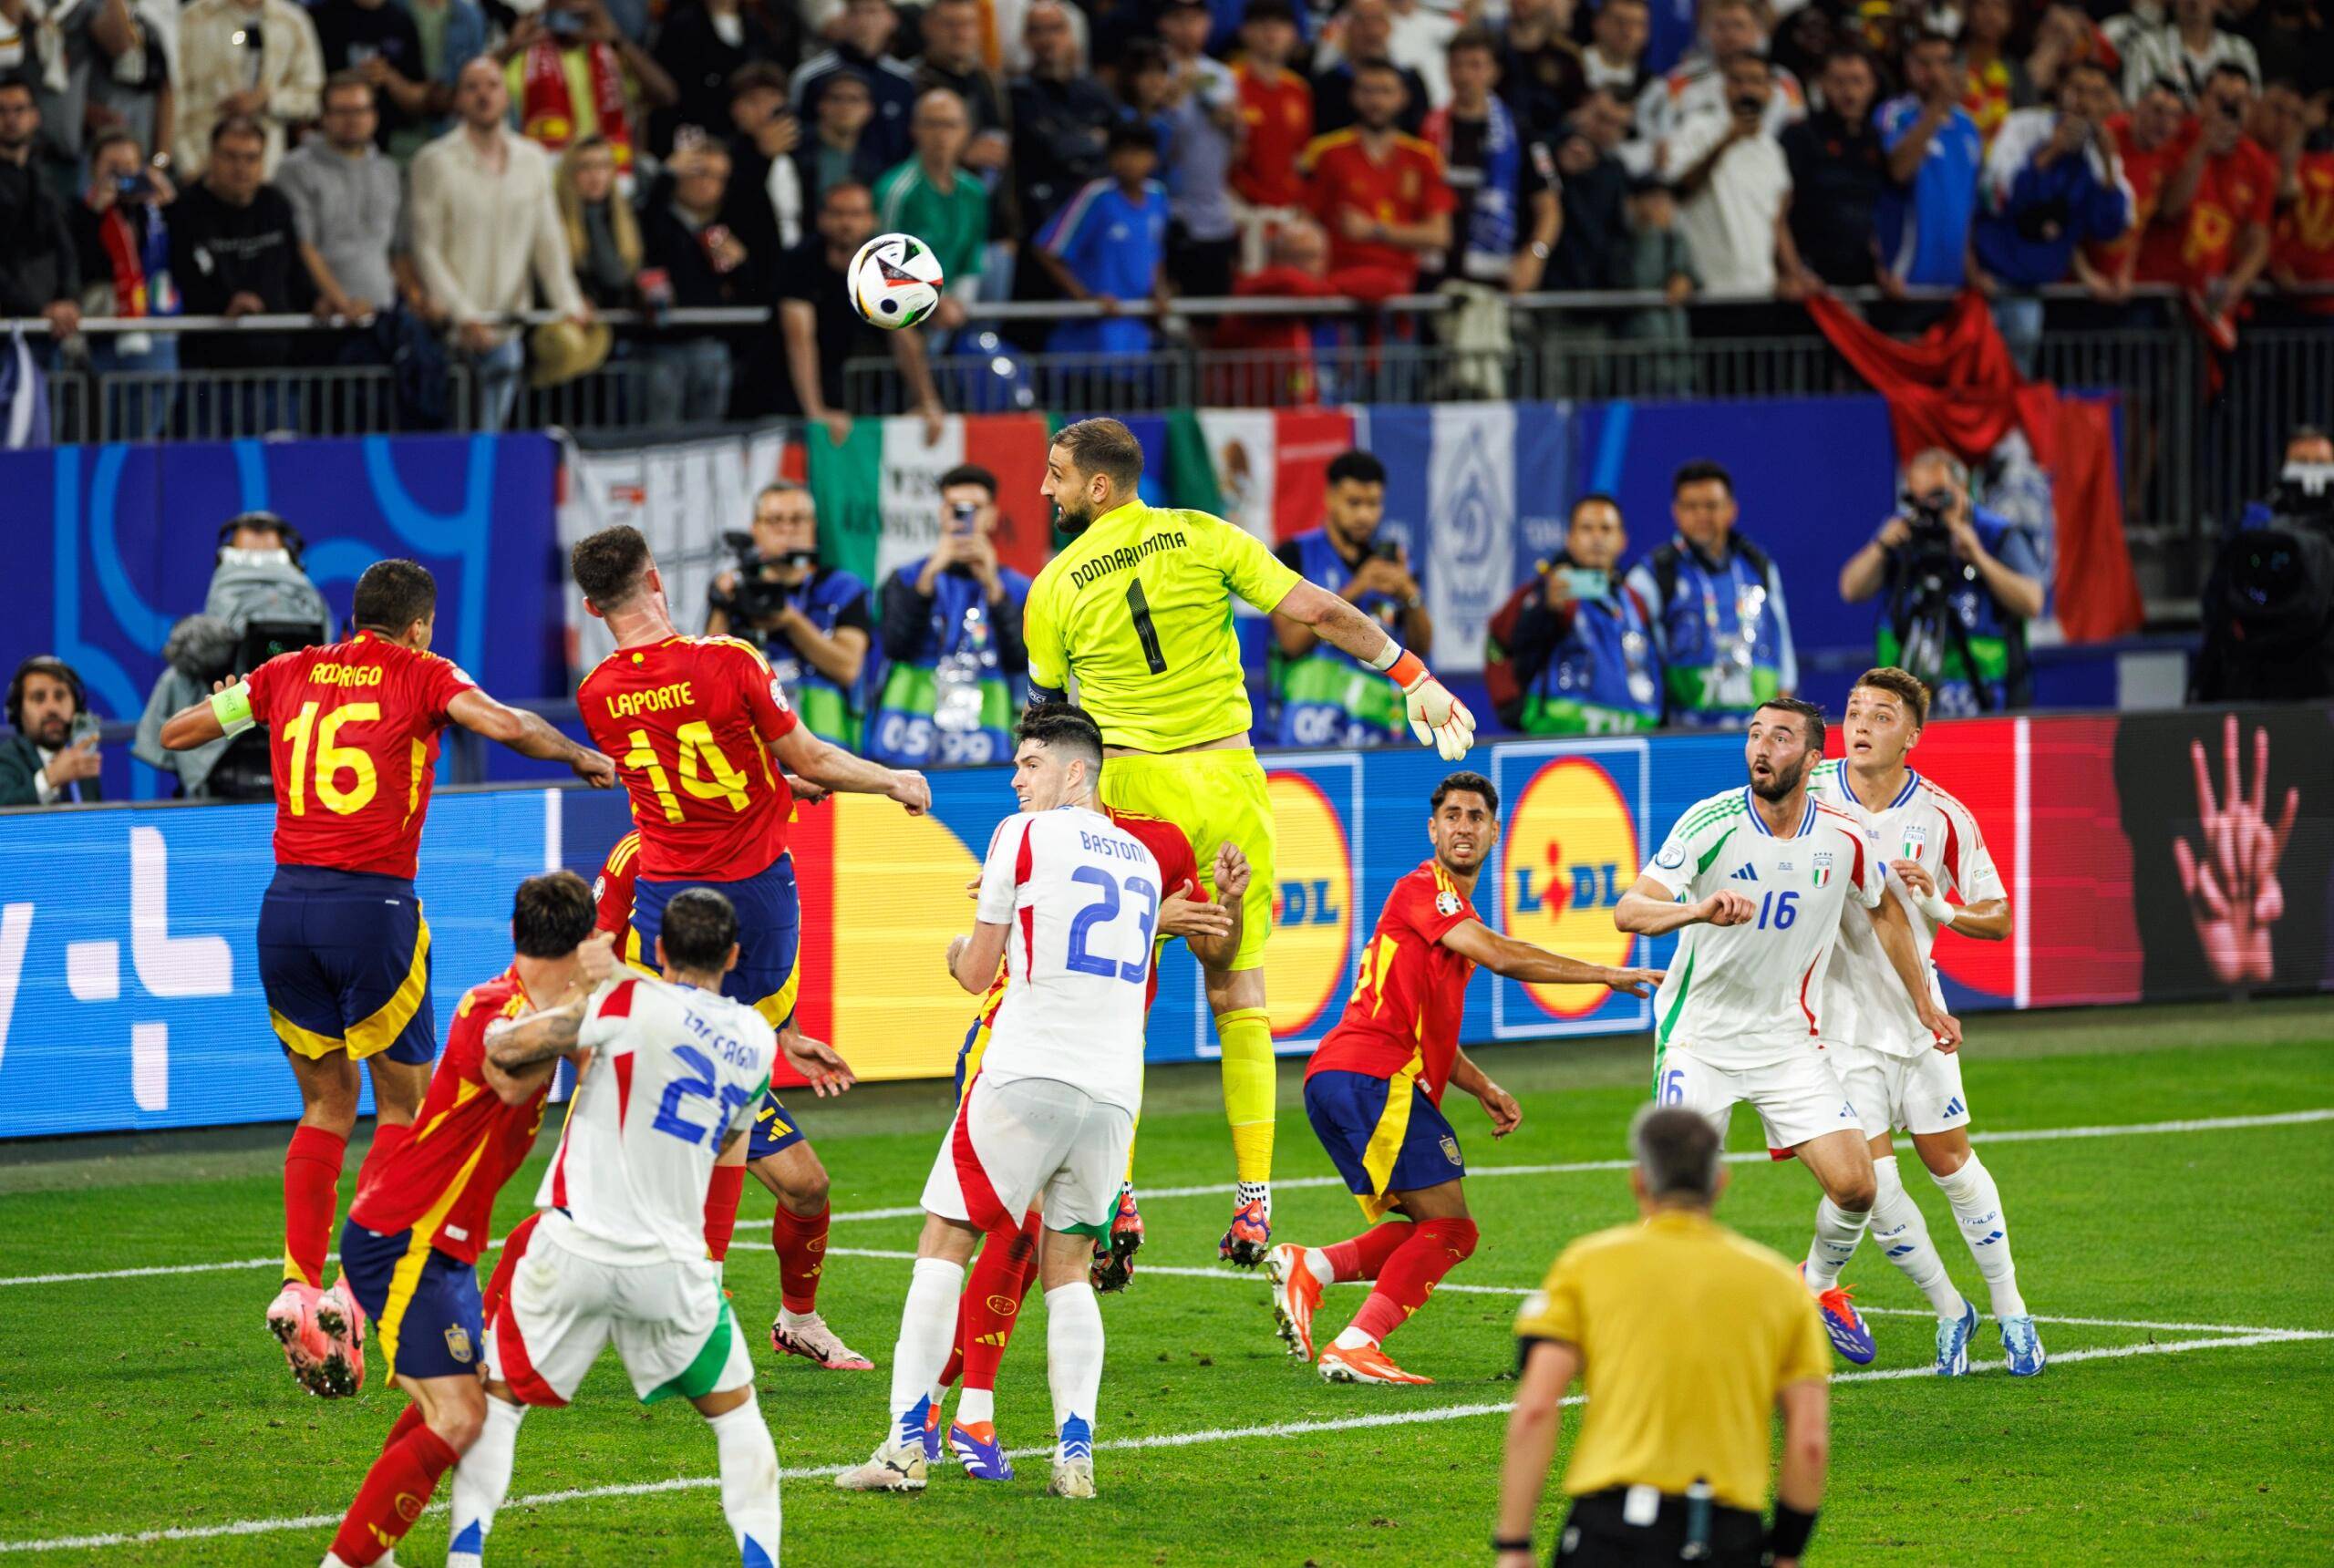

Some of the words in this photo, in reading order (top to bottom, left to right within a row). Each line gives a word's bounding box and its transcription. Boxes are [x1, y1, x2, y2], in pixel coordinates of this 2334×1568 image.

[1070, 531, 1187, 590] DONNARUMMA
[1125, 577, 1168, 676] 1
[308, 662, 383, 687] RODRIGO
[605, 681, 696, 719] LAPORTE
[283, 701, 381, 817] 16
[624, 720, 751, 824] 14
[1079, 830, 1147, 864] BASTONI
[1272, 880, 1338, 927] DL
[1516, 841, 1628, 923] LIDL
[1757, 890, 1801, 930] 16
[1066, 865, 1158, 985] 23
